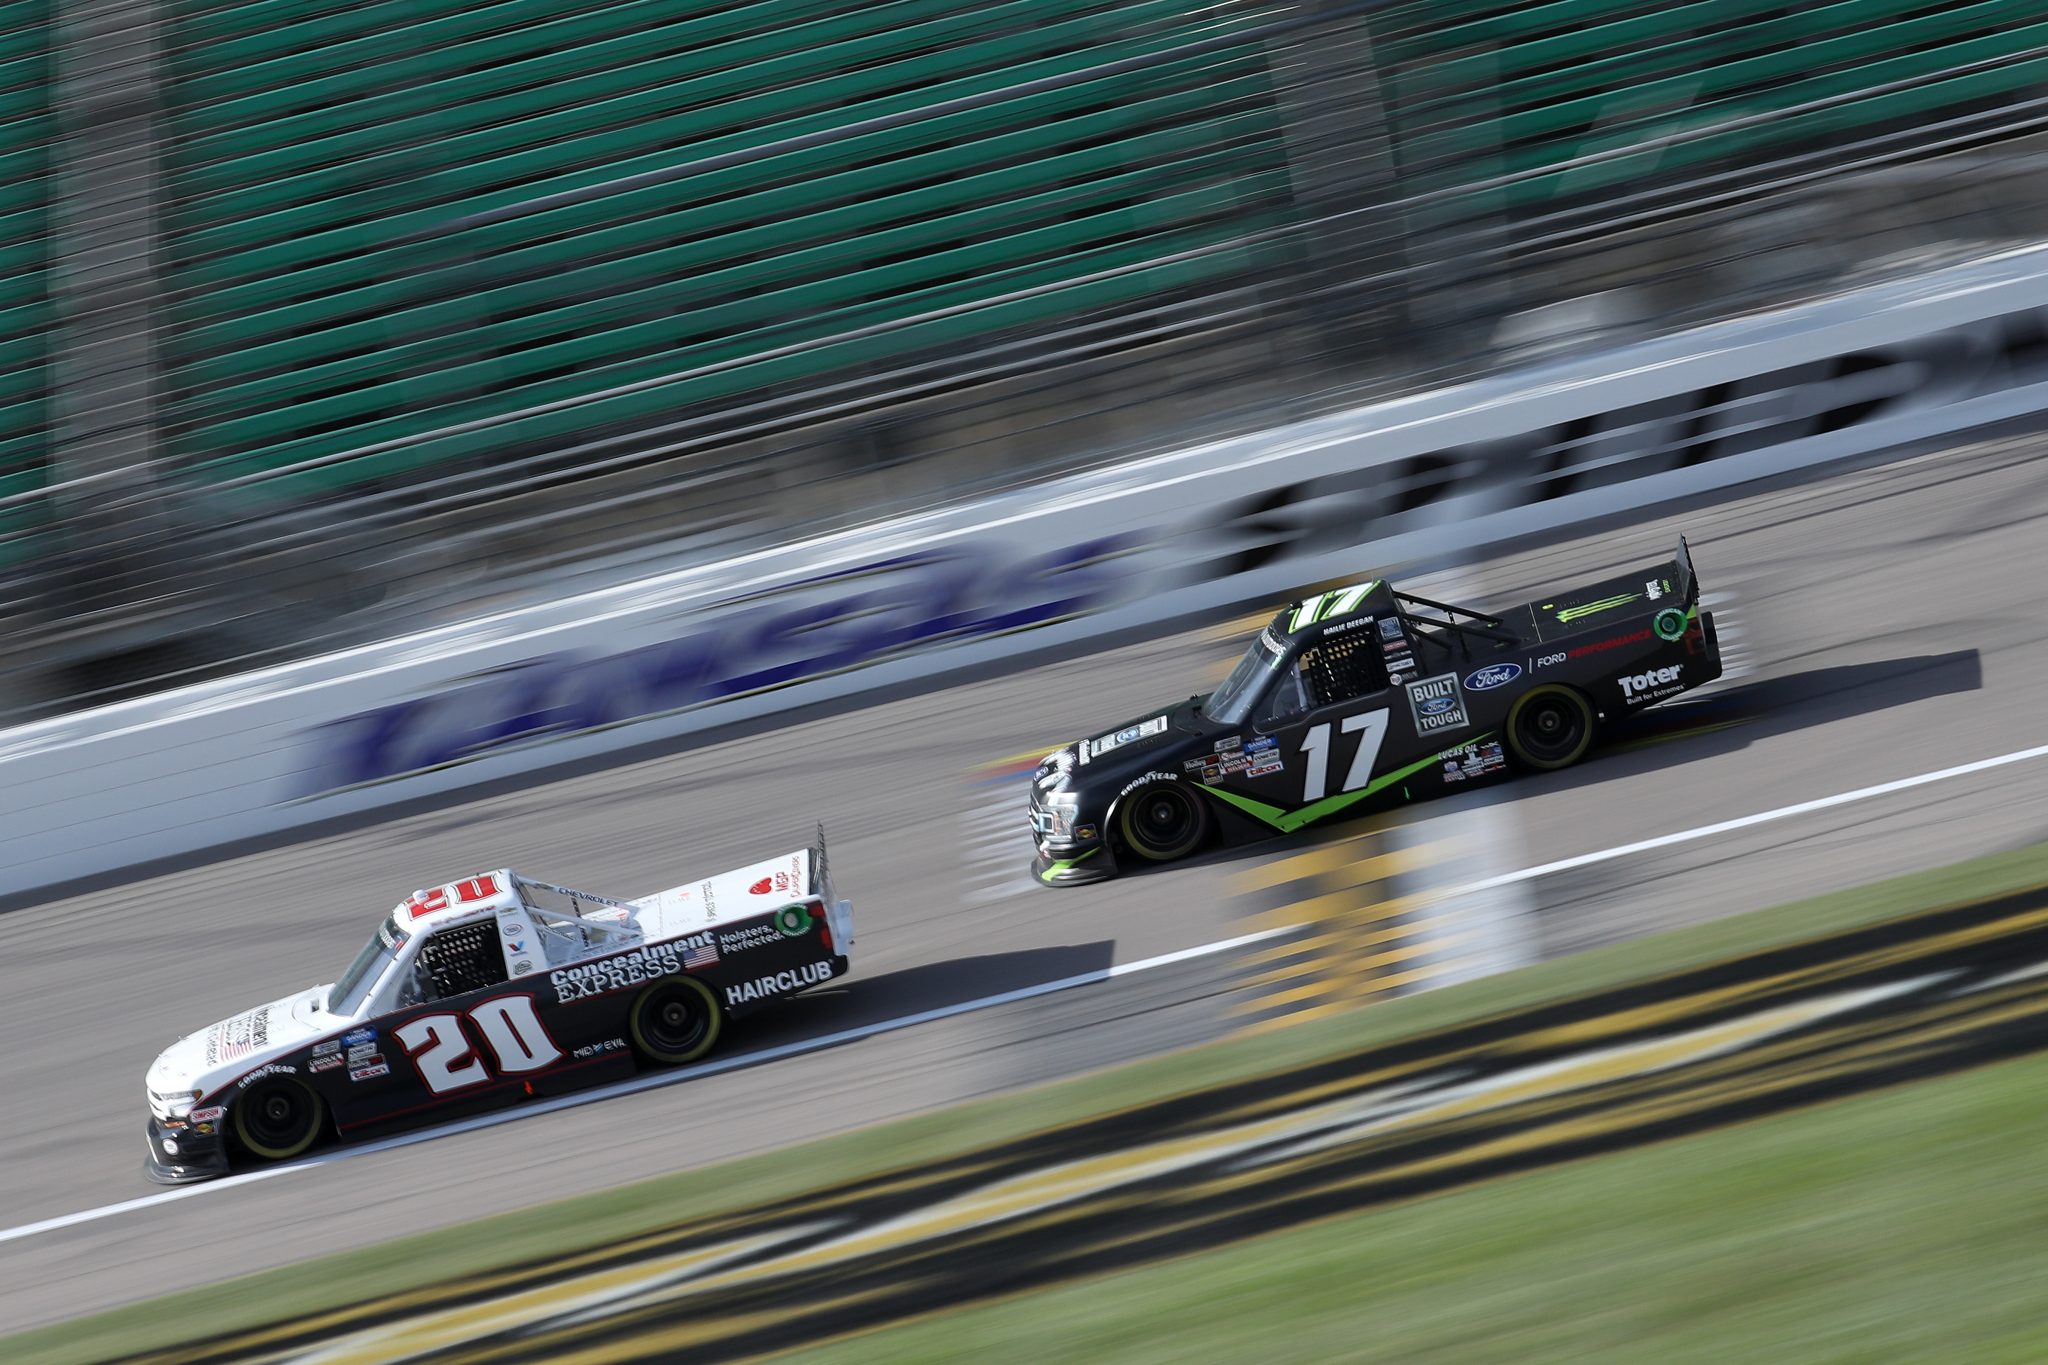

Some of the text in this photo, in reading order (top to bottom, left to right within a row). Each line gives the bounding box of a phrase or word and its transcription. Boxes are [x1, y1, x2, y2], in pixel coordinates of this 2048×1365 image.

[1288, 579, 1382, 634] 17
[1346, 615, 1374, 629] DEEGAN
[1537, 629, 1651, 668] FORD PERFORMANCE
[1413, 680, 1454, 701] BUILT
[1475, 668, 1513, 688] Ford
[1617, 664, 1681, 697] Toter
[1420, 709, 1462, 729] TOUGH
[1184, 759, 1206, 770] Holley
[1300, 707, 1390, 801] 17
[1438, 747, 1464, 760] LUCAS
[1464, 744, 1479, 754] OIL
[1121, 771, 1178, 797] GOODYEAR
[558, 887, 619, 907] CHEVROLET
[550, 930, 717, 986] Concealment
[555, 955, 681, 1005] EXPRESS
[726, 960, 833, 1005] HAIRCLUB
[392, 994, 565, 1095] 20
[238, 1063, 297, 1089] GOODYEAR
